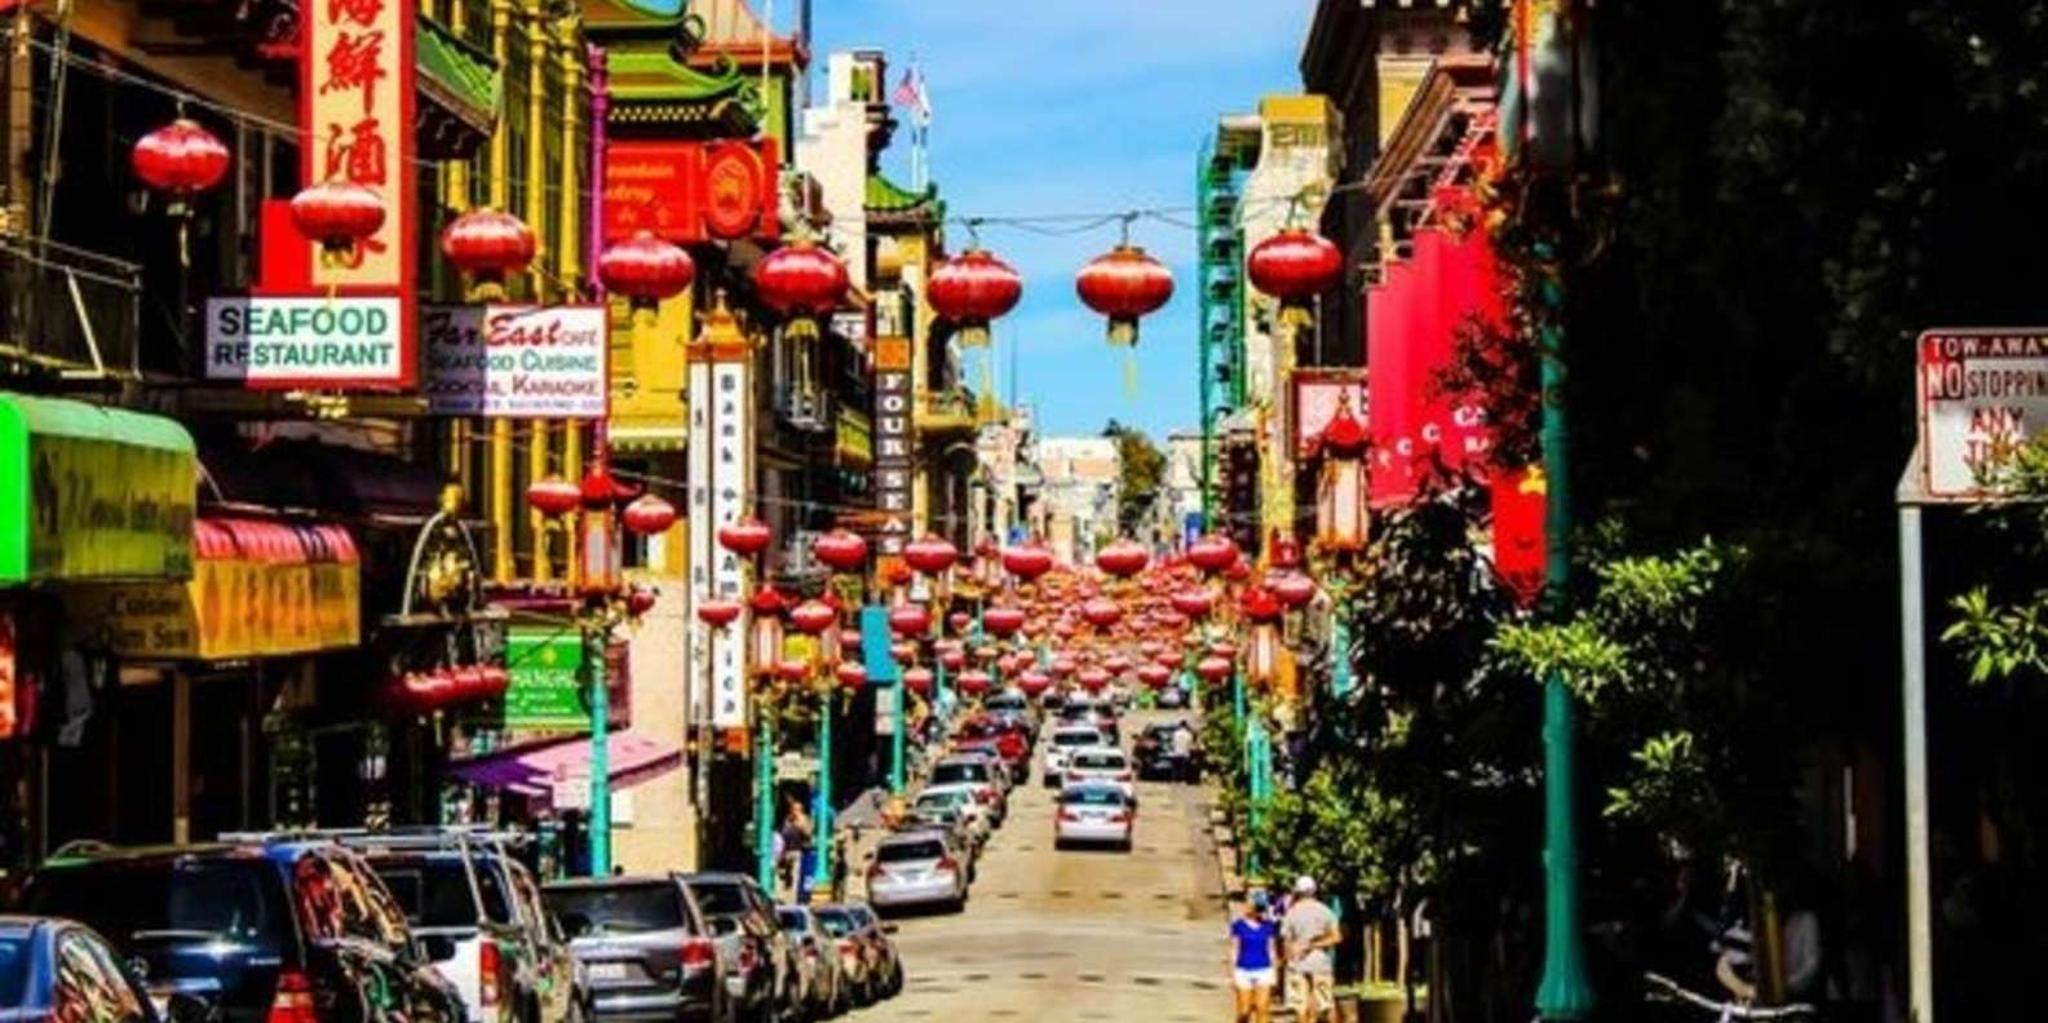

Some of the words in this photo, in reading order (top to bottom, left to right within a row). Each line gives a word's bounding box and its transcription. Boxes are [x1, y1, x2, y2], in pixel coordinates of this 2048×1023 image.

[319, 0, 388, 270] 鮮酒
[218, 307, 388, 336] SEAFOOD
[423, 312, 478, 347] Far
[487, 313, 562, 346] East
[214, 344, 393, 366] RESTAURANT
[1927, 362, 1963, 399] NO
[721, 373, 736, 463] Bank
[883, 374, 904, 456] FOUR
[1971, 406, 2023, 433] ANY
[883, 470, 904, 554] SEAS
[720, 554, 739, 714] Amrica
